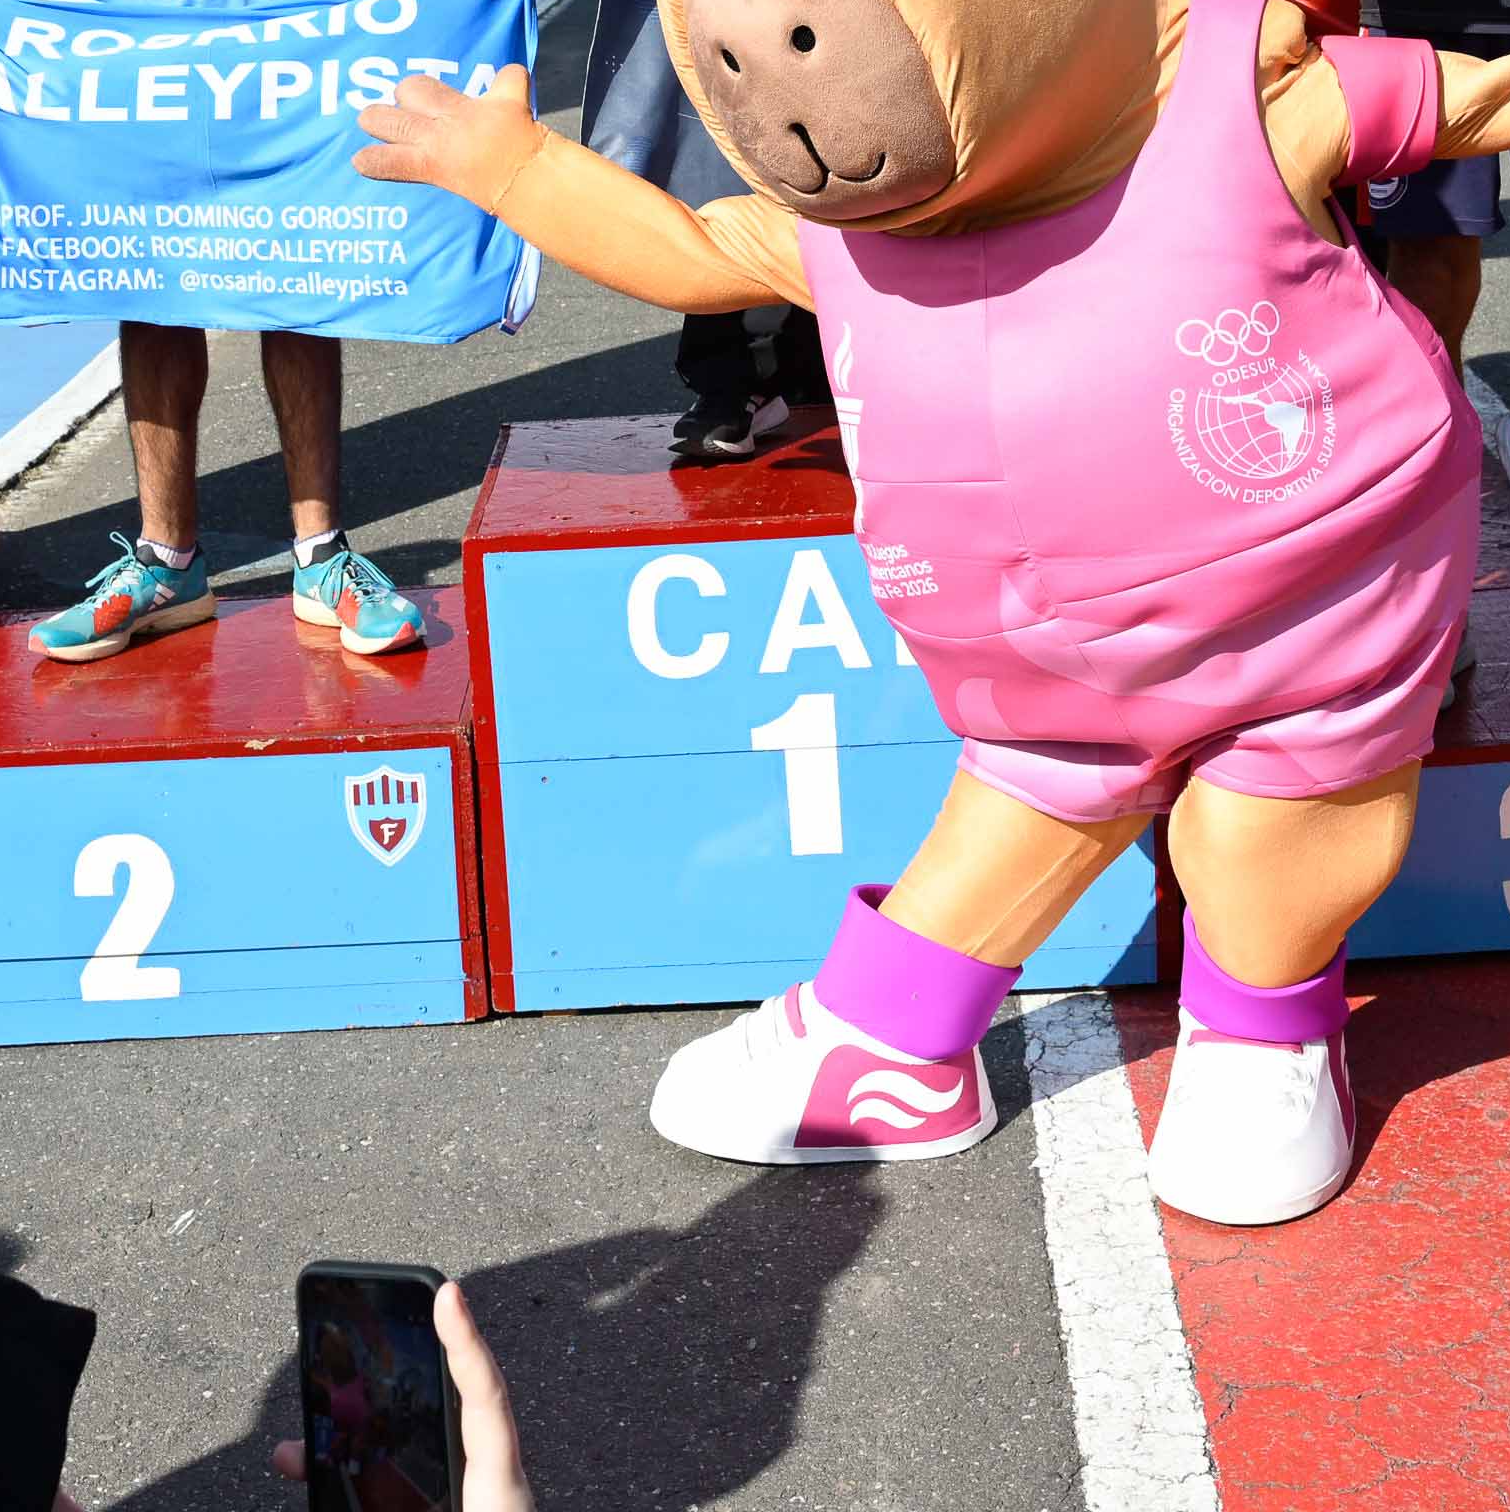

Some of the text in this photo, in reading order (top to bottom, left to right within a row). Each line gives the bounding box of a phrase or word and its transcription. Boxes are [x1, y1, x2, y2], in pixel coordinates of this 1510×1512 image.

[1, 204, 408, 230] PROF. JUAN DOMINGO GOROSITO
[1, 235, 407, 265] FACEBOOK: ROSARIOCALLEYPISTA
[0, 267, 409, 302] INSTAGRAM: @rosario.calleypista
[1212, 356, 1278, 388] ODESUR
[1167, 348, 1338, 504] ORGANIZACION DEPORTIVA SURAMERICANA
[900, 576, 940, 597] 2026
[627, 549, 915, 681] CA
[751, 694, 843, 856] 1
[379, 822, 399, 845] F
[74, 833, 181, 1002] 2
